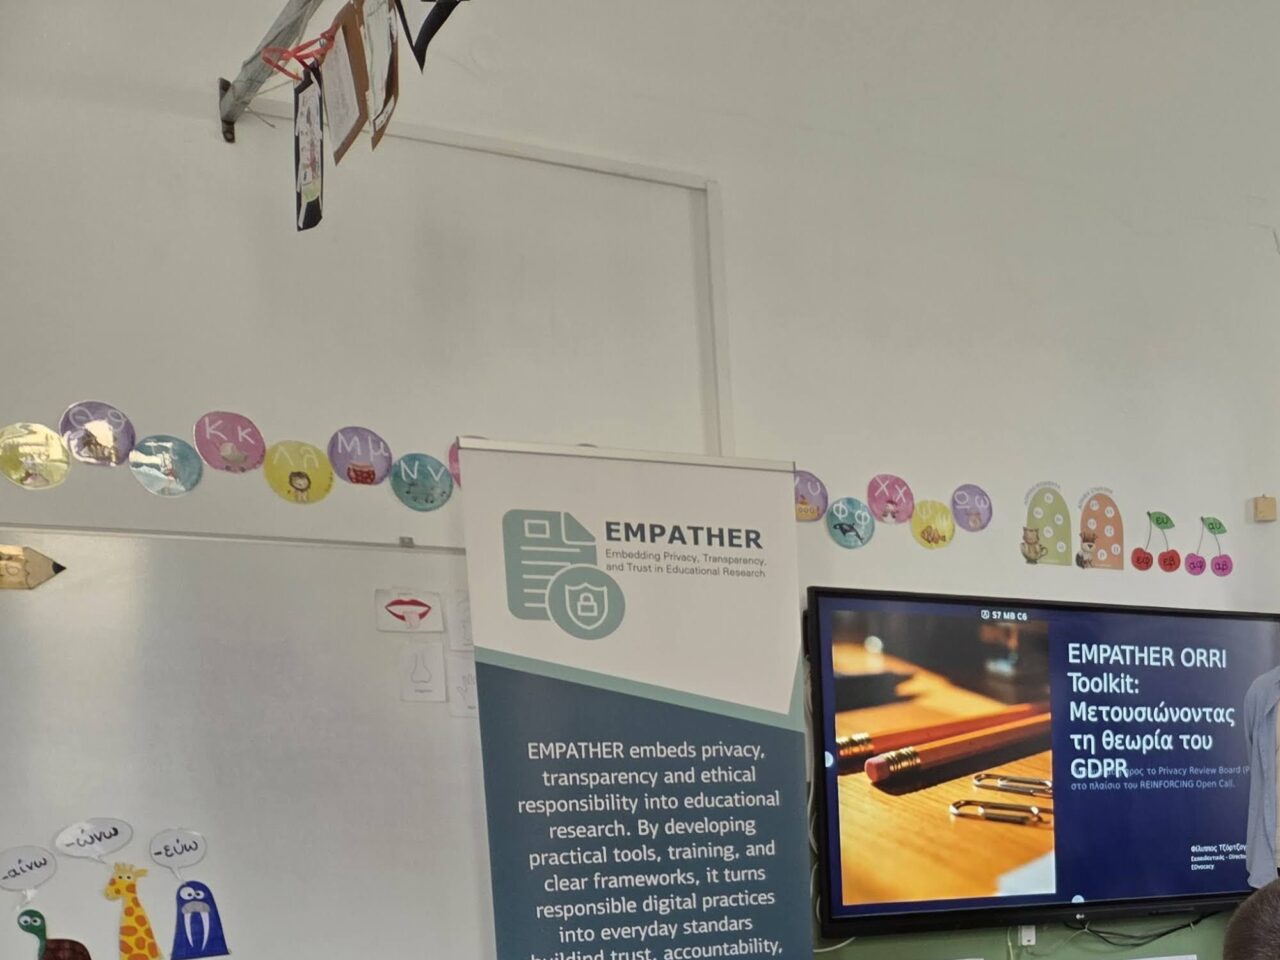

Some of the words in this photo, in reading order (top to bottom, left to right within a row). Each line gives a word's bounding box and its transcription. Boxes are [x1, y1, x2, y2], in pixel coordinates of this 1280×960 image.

[605, 521, 763, 549] EMPATHER
[605, 549, 661, 563] Embedding
[663, 551, 700, 565] Privacy,
[606, 562, 625, 572] and
[627, 563, 652, 573] Trust
[654, 564, 664, 573] in
[666, 564, 720, 577] Educational
[723, 566, 766, 578] Research
[1068, 643, 1175, 667] EMPATHER
[1181, 648, 1227, 668] ORRI
[1067, 672, 1140, 694] Toolkit:
[1070, 701, 1235, 727] Μετουσιώνοντας
[528, 742, 624, 760] EMPATHER
[629, 741, 696, 759] embeds
[701, 740, 765, 761] privacy,
[1070, 733, 1096, 754] τη
[1102, 729, 1173, 755] θεωρία
[1179, 734, 1213, 750] του
[542, 769, 658, 788] transparency
[664, 767, 695, 784] and
[701, 766, 756, 783] ethical
[1070, 758, 1129, 779] GDPR
[1158, 766, 1187, 777] Privacy
[1189, 766, 1215, 775] Review
[1218, 766, 1241, 774] Board
[1124, 782, 1138, 790] του
[1140, 780, 1194, 789] REINFORCING
[1196, 780, 1216, 790] Open
[518, 794, 638, 816] responsibility
[644, 793, 678, 810] into
[684, 790, 780, 809] educational
[549, 820, 631, 839] research.
[638, 819, 658, 839] By
[664, 816, 757, 837] developing
[529, 847, 607, 871] practical
[613, 845, 661, 864] tools,
[668, 842, 740, 862] training,
[745, 840, 776, 857] and
[544, 874, 588, 892] clear
[593, 868, 700, 891] frameworks,
[706, 867, 719, 884] it
[723, 867, 766, 883] turns
[536, 897, 637, 920] responsible
[642, 892, 697, 916] digital
[702, 890, 775, 912] practices
[559, 925, 596, 943] into
[601, 921, 678, 942] everyday
[683, 915, 753, 935] standars
